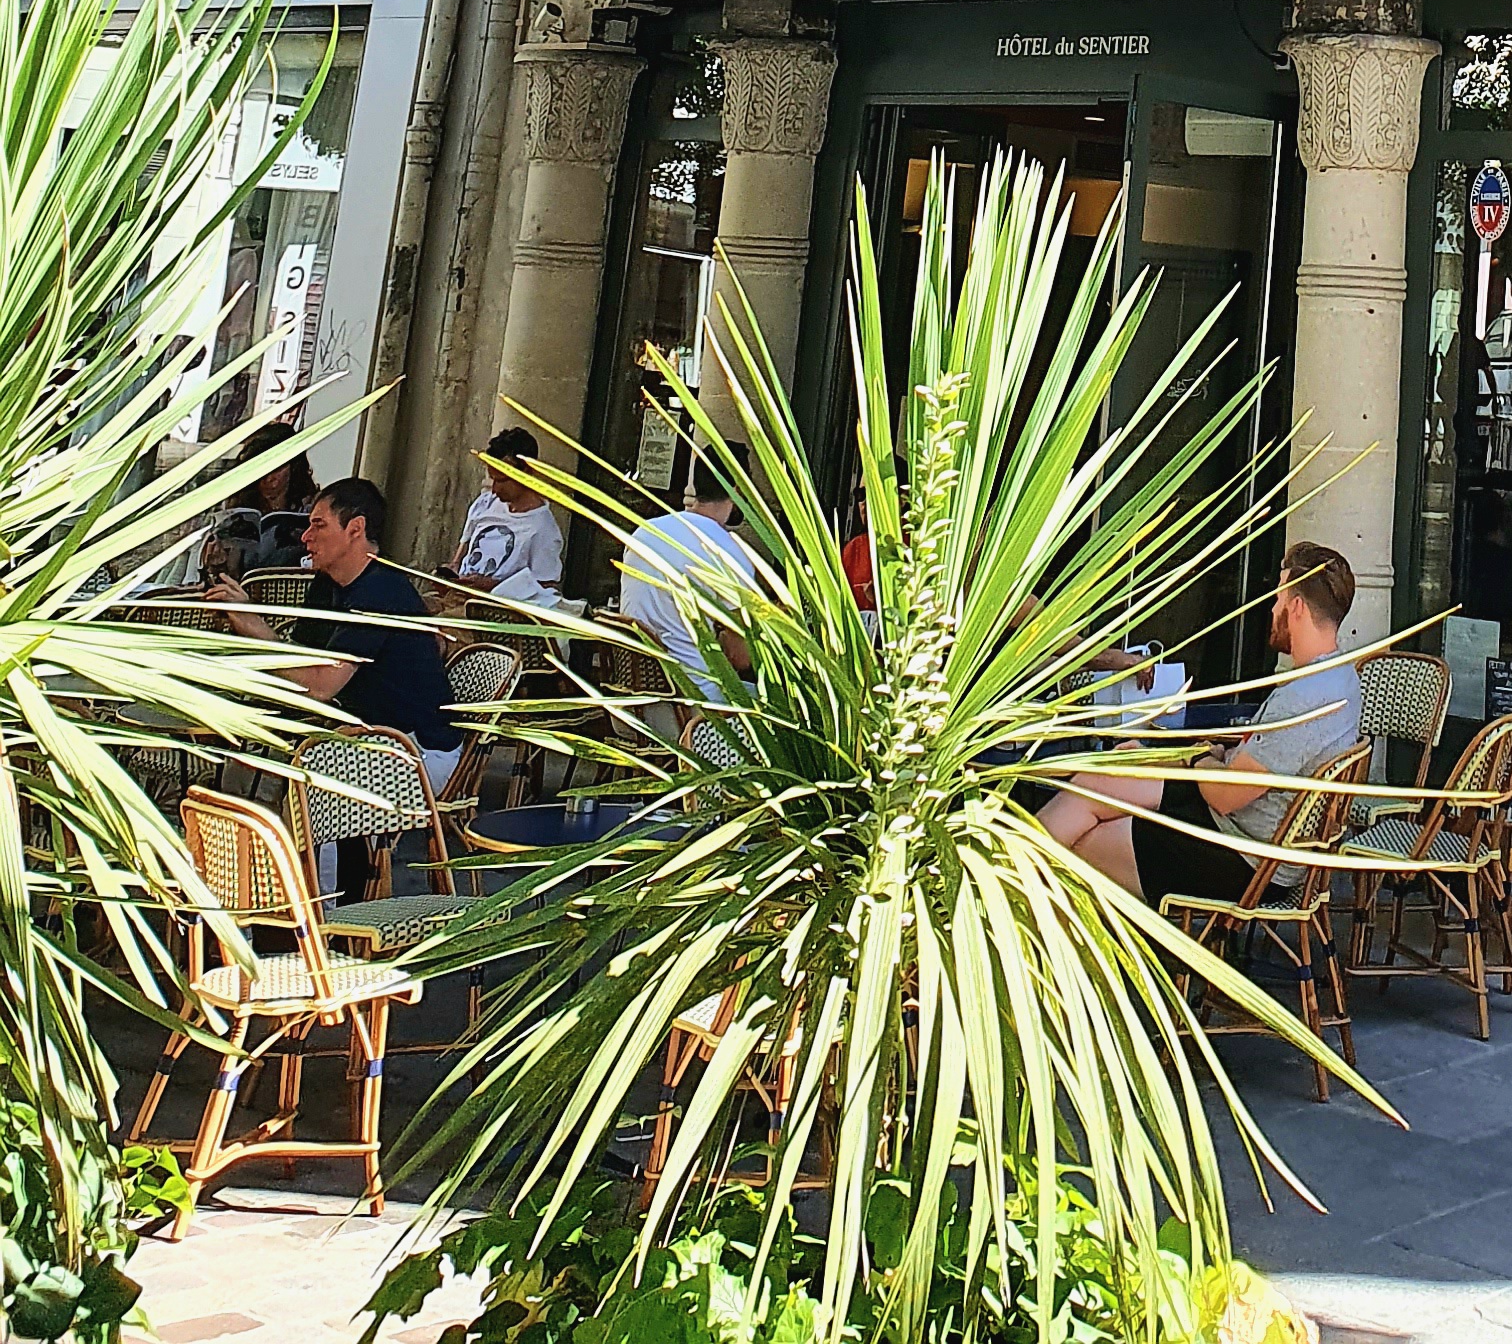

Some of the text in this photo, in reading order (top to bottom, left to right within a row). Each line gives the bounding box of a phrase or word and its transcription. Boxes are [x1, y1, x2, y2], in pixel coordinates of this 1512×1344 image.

[996, 33, 1150, 56] HÔTEL du SENTIER
[1483, 205, 1500, 223] IV
